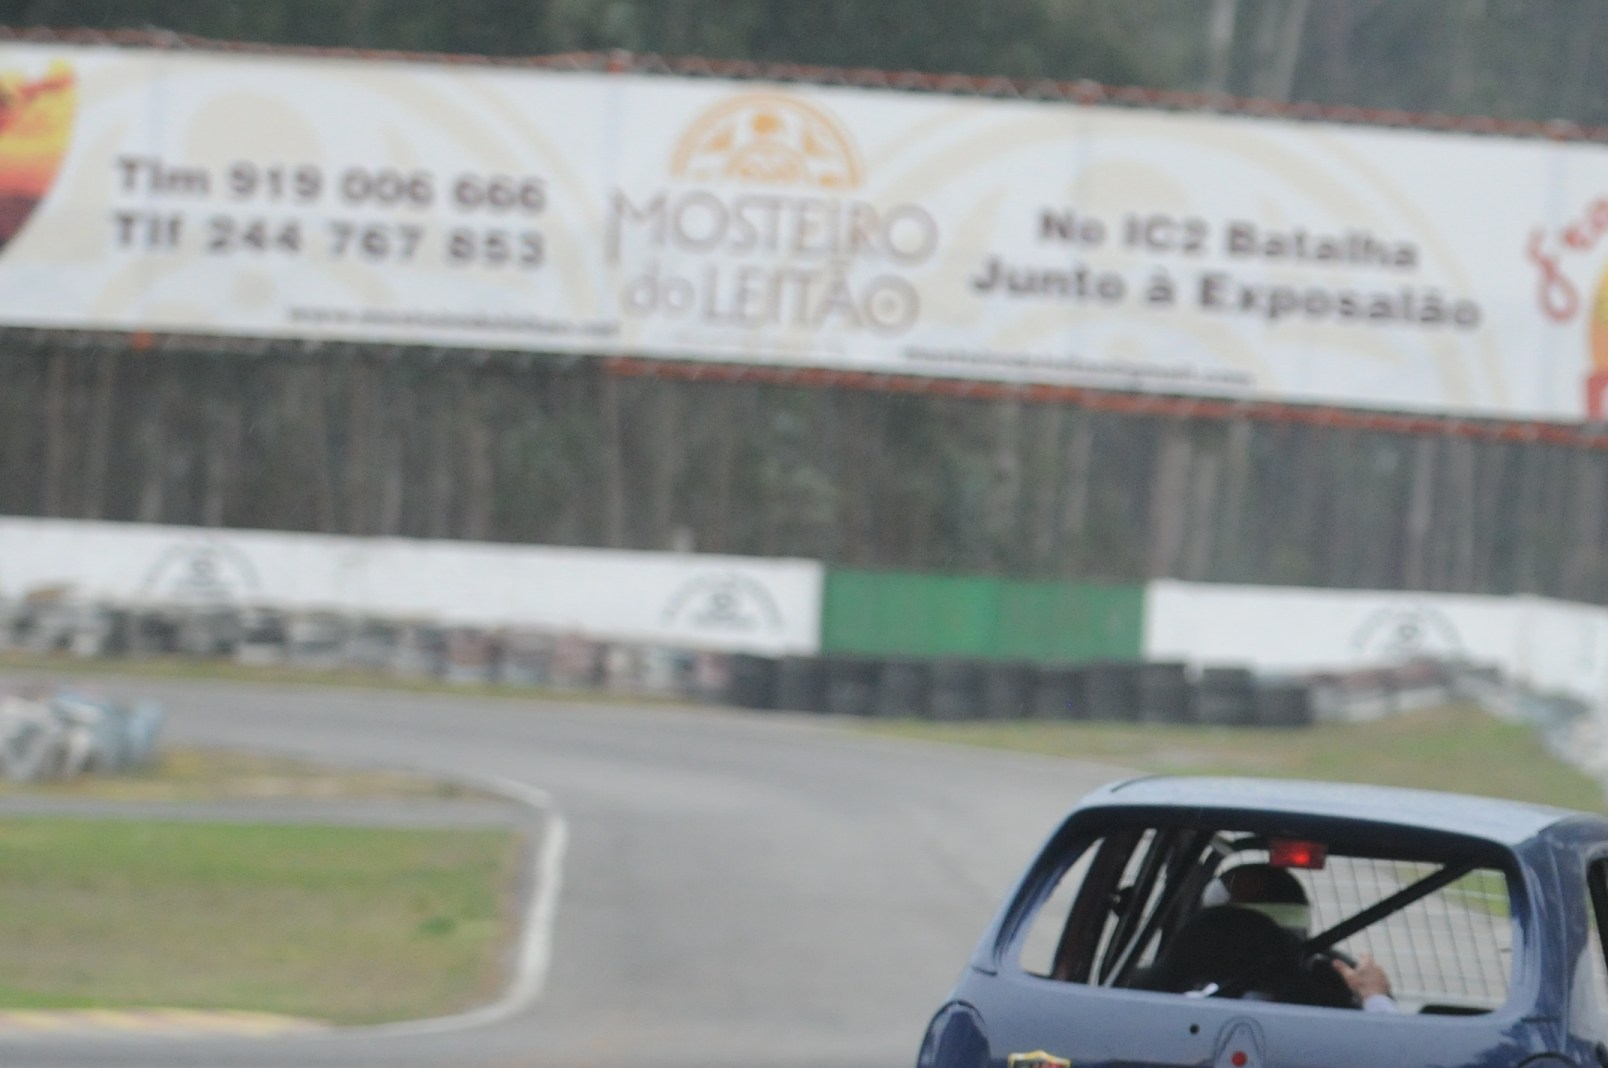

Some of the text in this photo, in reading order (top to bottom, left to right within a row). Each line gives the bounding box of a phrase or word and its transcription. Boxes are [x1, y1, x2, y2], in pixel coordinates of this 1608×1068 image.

[229, 161, 322, 200] 919
[342, 167, 436, 208] 006
[454, 173, 546, 213] 666
[208, 215, 302, 254] 244
[329, 221, 424, 264] 767
[448, 226, 544, 269] 853
[604, 188, 939, 268] MOSTEIRO
[1039, 207, 1419, 269] No IC2 Batalha
[621, 258, 696, 319] do
[701, 258, 921, 338] LEITÃO
[972, 254, 1481, 329] Junto à Exposalão
